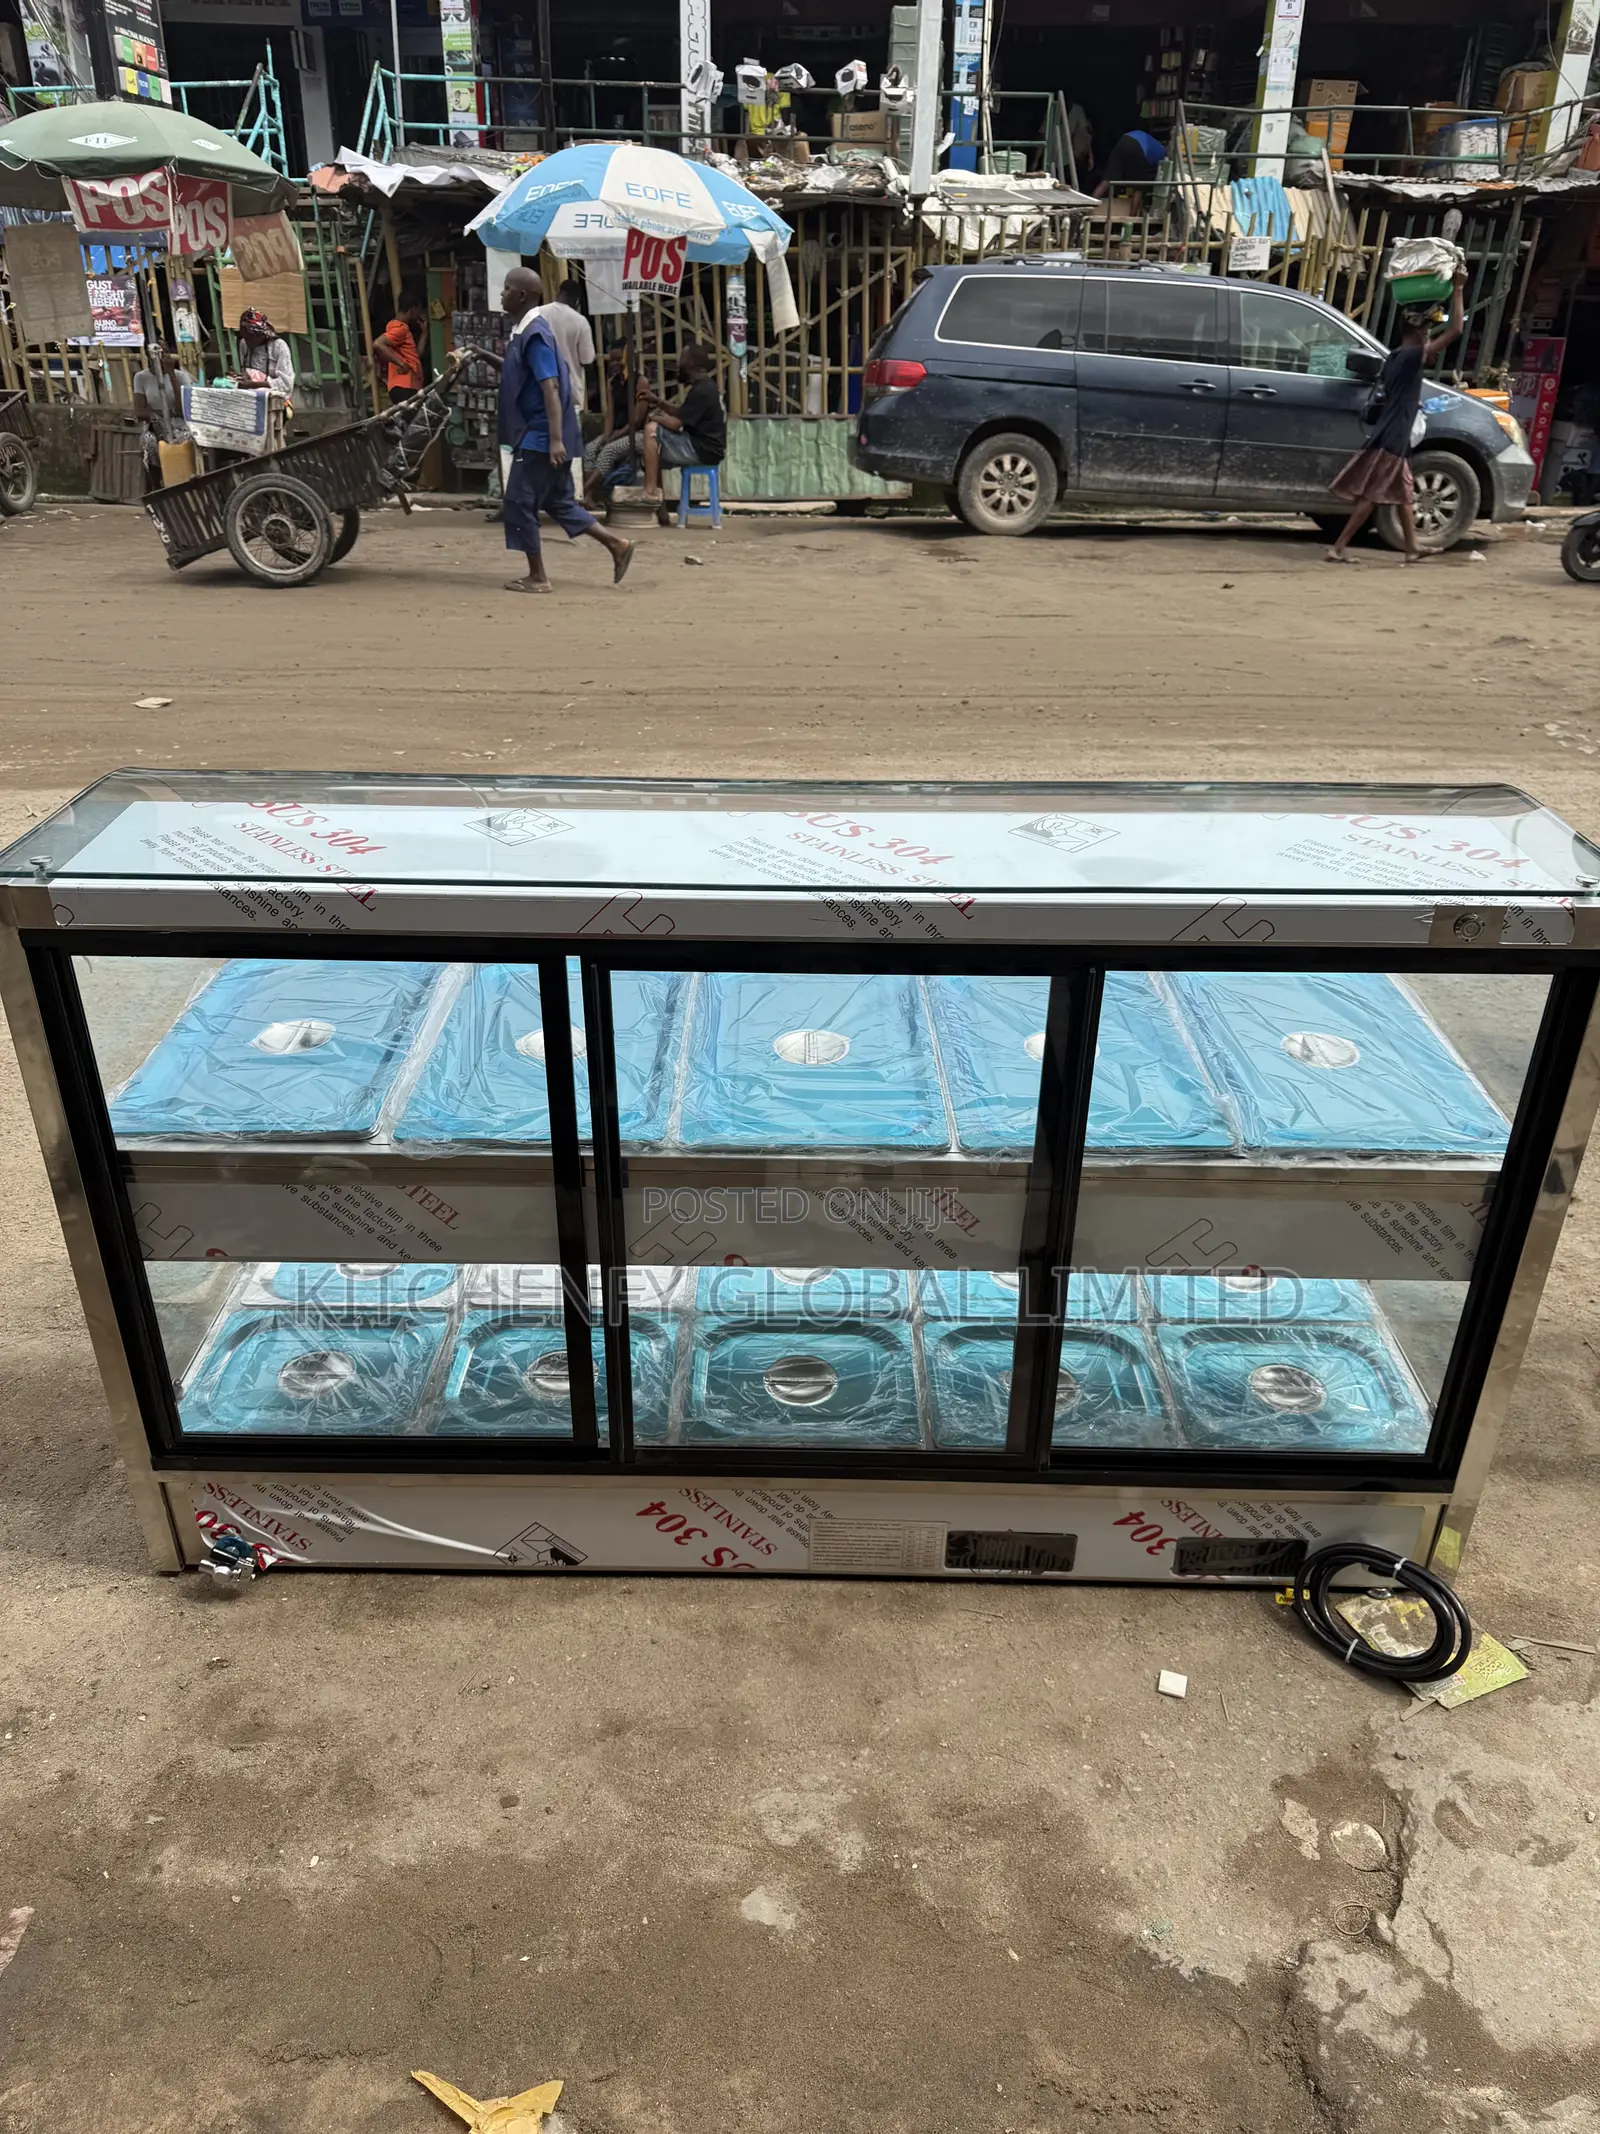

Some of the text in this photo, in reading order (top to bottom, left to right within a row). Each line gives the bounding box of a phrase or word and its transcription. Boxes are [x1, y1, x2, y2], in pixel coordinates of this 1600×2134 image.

[76, 172, 170, 225] POS
[625, 182, 693, 209] EOFE
[172, 197, 226, 255] POS
[622, 227, 687, 284] POS
[658, 283, 678, 294] HERE
[309, 828, 387, 855] 304
[868, 838, 954, 866] 304
[1341, 833, 1494, 880] STAINLESS
[1432, 840, 1530, 869] 304
[233, 821, 379, 911] STAINLESS STEL
[786, 831, 979, 920] STAINLESS STEL
[1276, 851, 1309, 863] away
[1312, 861, 1340, 872] from
[1285, 846, 1420, 888] Please do not expose
[1293, 843, 1337, 858] months
[1355, 861, 1411, 880] products
[1302, 838, 1343, 852] Please
[1347, 851, 1370, 861] tear
[1375, 858, 1408, 872] down
[1412, 869, 1433, 878] the
[1521, 915, 1534, 929] in
[314, 902, 326, 916] in
[329, 914, 351, 930] thr
[912, 910, 925, 925] in
[924, 922, 945, 939] thr
[300, 1194, 356, 1239] substances.
[318, 1190, 331, 1202] to
[332, 1201, 376, 1235] sunshine
[376, 1233, 398, 1250] and
[344, 1194, 397, 1237] the factory.
[385, 1206, 443, 1253] film in three
[845, 1198, 913, 1257] to sunshine and
[871, 1200, 917, 1244] the factory.
[924, 1230, 935, 1241] in
[934, 1238, 958, 1260] three
[1360, 1212, 1405, 1256] substances.
[1380, 1208, 1454, 1280] to sunshine and kee
[1404, 1211, 1446, 1254] the factory.
[1440, 1224, 1466, 1251] film in
[268, 1492, 293, 1510] down
[299, 1487, 315, 1500] not
[316, 1498, 329, 1509] do
[322, 1490, 370, 1523] away from
[745, 1496, 768, 1515] down
[752, 1488, 795, 1520] of product
[777, 1491, 805, 1514] do not
[801, 1493, 821, 1511] from
[203, 1482, 313, 1551] STAINLESS
[307, 1506, 319, 1516] of
[636, 1500, 708, 1546] 304
[677, 1488, 779, 1556] STAINLESS
[768, 1513, 786, 1528] tear
[1226, 1507, 1248, 1525] down
[1259, 1502, 1286, 1524] do not
[1262, 1520, 1272, 1530] of
[1284, 1506, 1322, 1539] away from
[315, 1521, 346, 1544] Please
[1112, 1510, 1177, 1556] 304
[1246, 1525, 1263, 1539] tear
